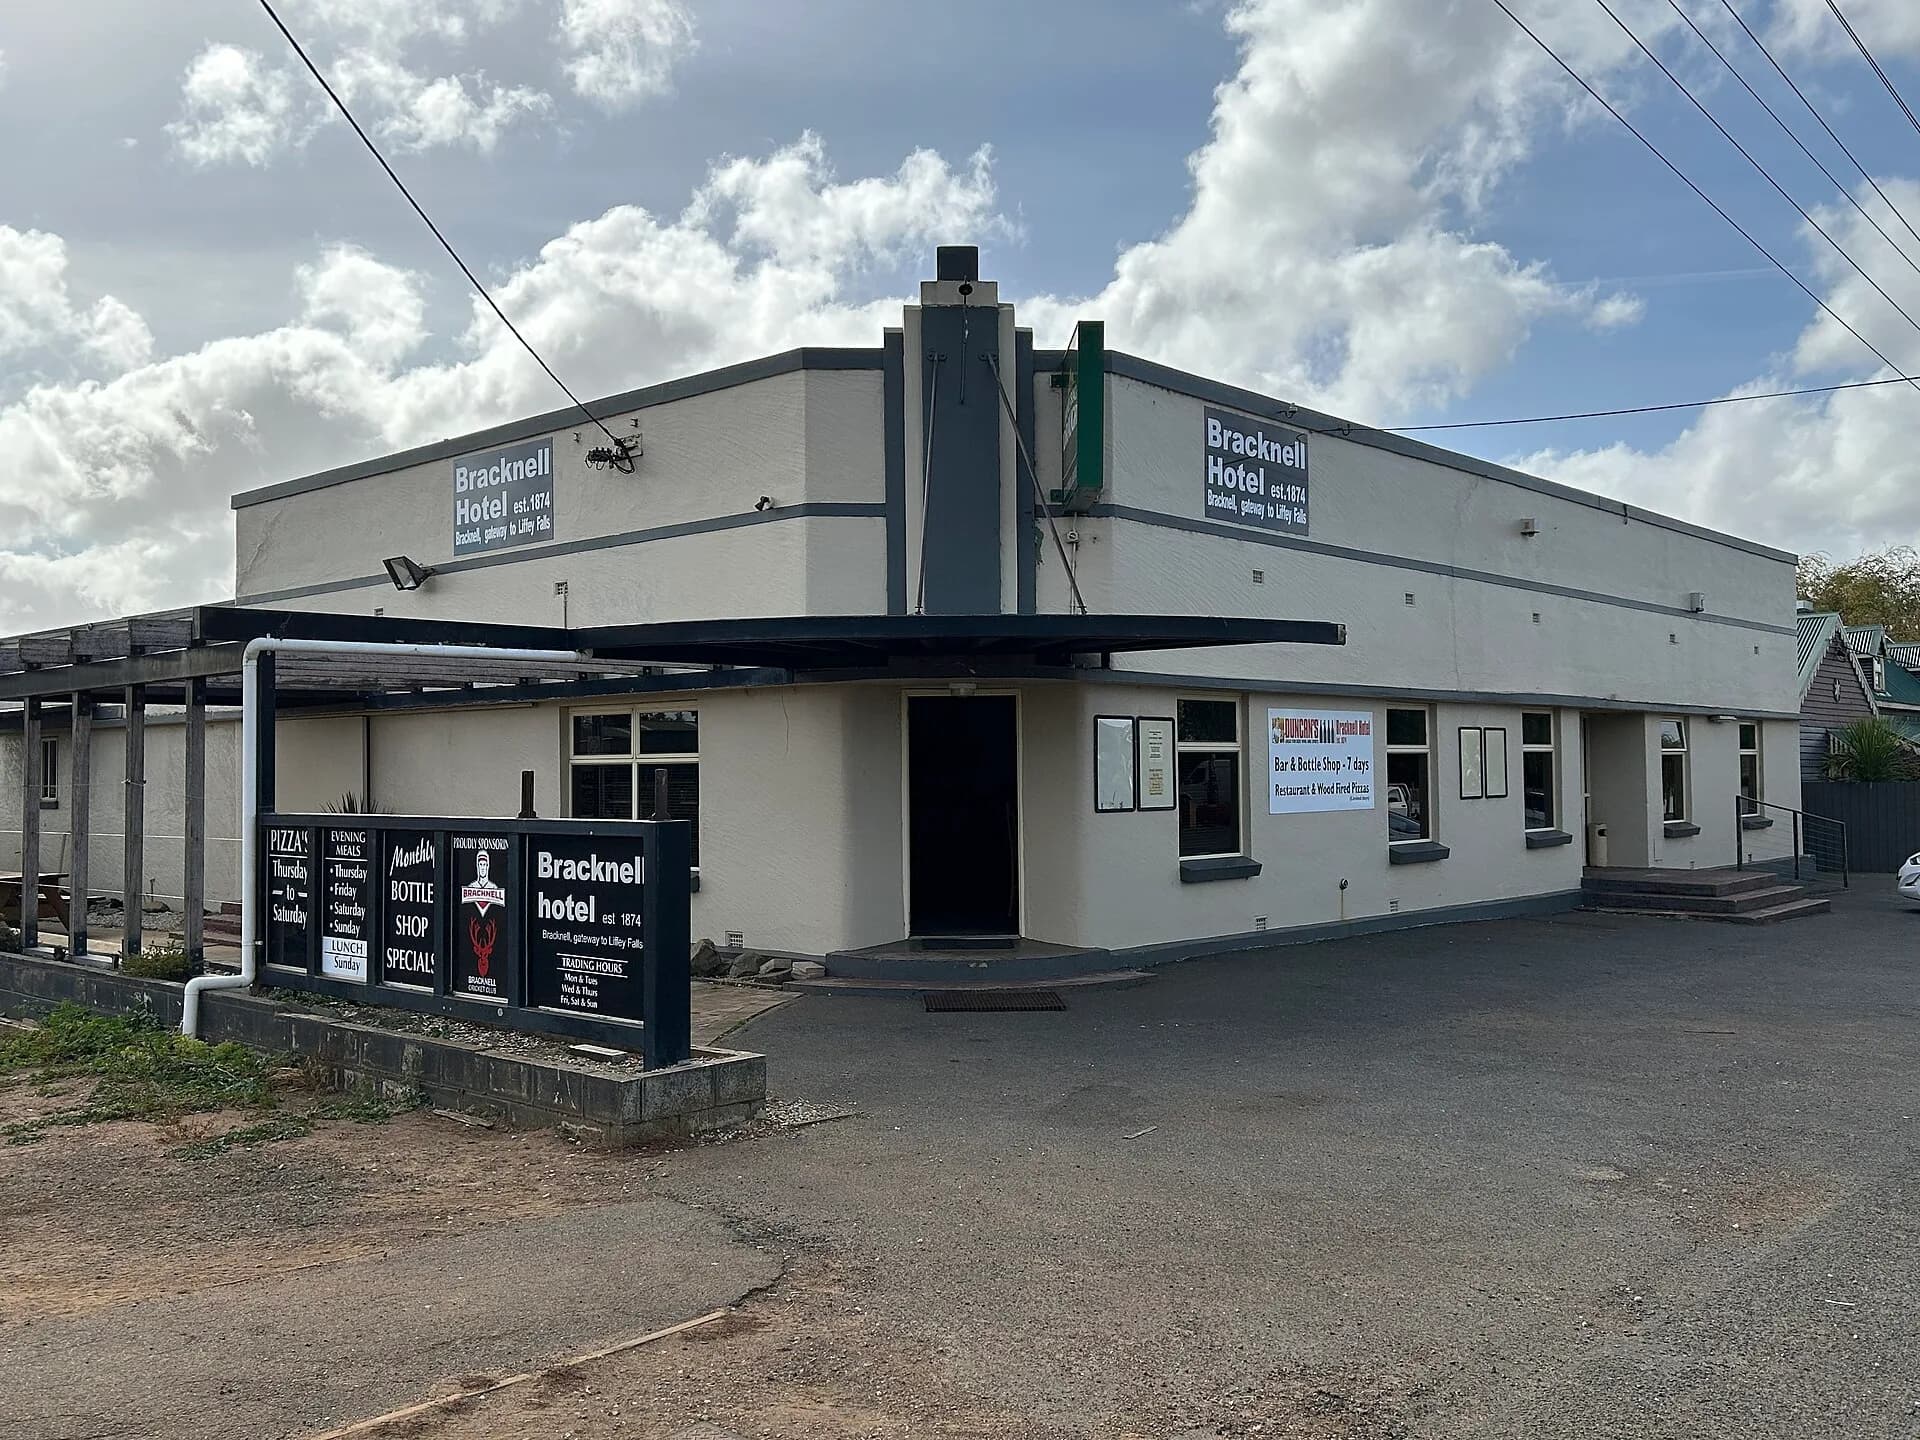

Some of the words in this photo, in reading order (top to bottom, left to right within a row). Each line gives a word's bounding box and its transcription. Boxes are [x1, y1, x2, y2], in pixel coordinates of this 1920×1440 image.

[1208, 418, 1305, 470] Bracknell
[456, 448, 549, 493] Bracknell
[1208, 455, 1264, 495] Hotel
[456, 491, 507, 525] Hotel
[1208, 489, 1237, 514] Bracknell,
[1241, 499, 1264, 520] gateway
[1268, 502, 1274, 518] to
[1276, 504, 1292, 525] Liffey
[1294, 507, 1306, 524] Falls
[456, 528, 482, 545] Bracknell,
[484, 524, 507, 544] gateway
[510, 522, 516, 535] to
[518, 519, 535, 536] Liffey
[537, 515, 550, 531] Falls
[1275, 757, 1288, 771] Bar
[1290, 757, 1296, 771] &
[1298, 757, 1321, 771] Bottle
[1322, 756, 1341, 775] Shop
[1347, 757, 1351, 770] 7
[1354, 756, 1369, 774] days
[1275, 784, 1310, 796] Restaurant
[1312, 783, 1316, 794] &
[1317, 783, 1334, 794] Wood
[1336, 782, 1350, 794] Fired
[1352, 782, 1369, 794] Pizzas
[331, 831, 366, 842] EVENING
[454, 838, 477, 849] PROUDLY
[336, 845, 360, 856] MEALS
[389, 837, 435, 876] Monthly
[273, 859, 307, 885] Thursday
[334, 864, 367, 883] Thursday
[286, 884, 294, 900] to
[334, 883, 357, 900] Friday
[391, 880, 433, 904] BOTTLE
[273, 904, 307, 930] Saturday
[334, 902, 366, 920] Saturday
[538, 892, 595, 922] hotel
[602, 913, 615, 925] est
[621, 913, 641, 927] 1874
[334, 920, 360, 938] Sunday
[396, 914, 428, 938] SHOP
[332, 941, 363, 954] LUNCH
[543, 930, 572, 942] Bracknell,
[573, 933, 600, 947] gateway
[600, 935, 607, 945] to
[609, 936, 626, 949] Liffey
[628, 938, 643, 949] Falls
[334, 956, 360, 975] Sunday
[562, 958, 594, 971] TRADING
[596, 961, 623, 974] HOURS
[468, 976, 496, 986] BRACKNELL
[564, 973, 577, 983] Mon
[579, 975, 584, 983] &
[585, 976, 598, 985] Tues
[562, 984, 574, 994] Wed
[576, 986, 581, 994] &
[582, 986, 598, 997] Thurs
[561, 995, 570, 1005] Fri,
[571, 997, 580, 1006] Sat
[581, 998, 586, 1006] &
[587, 999, 598, 1008] Sun
